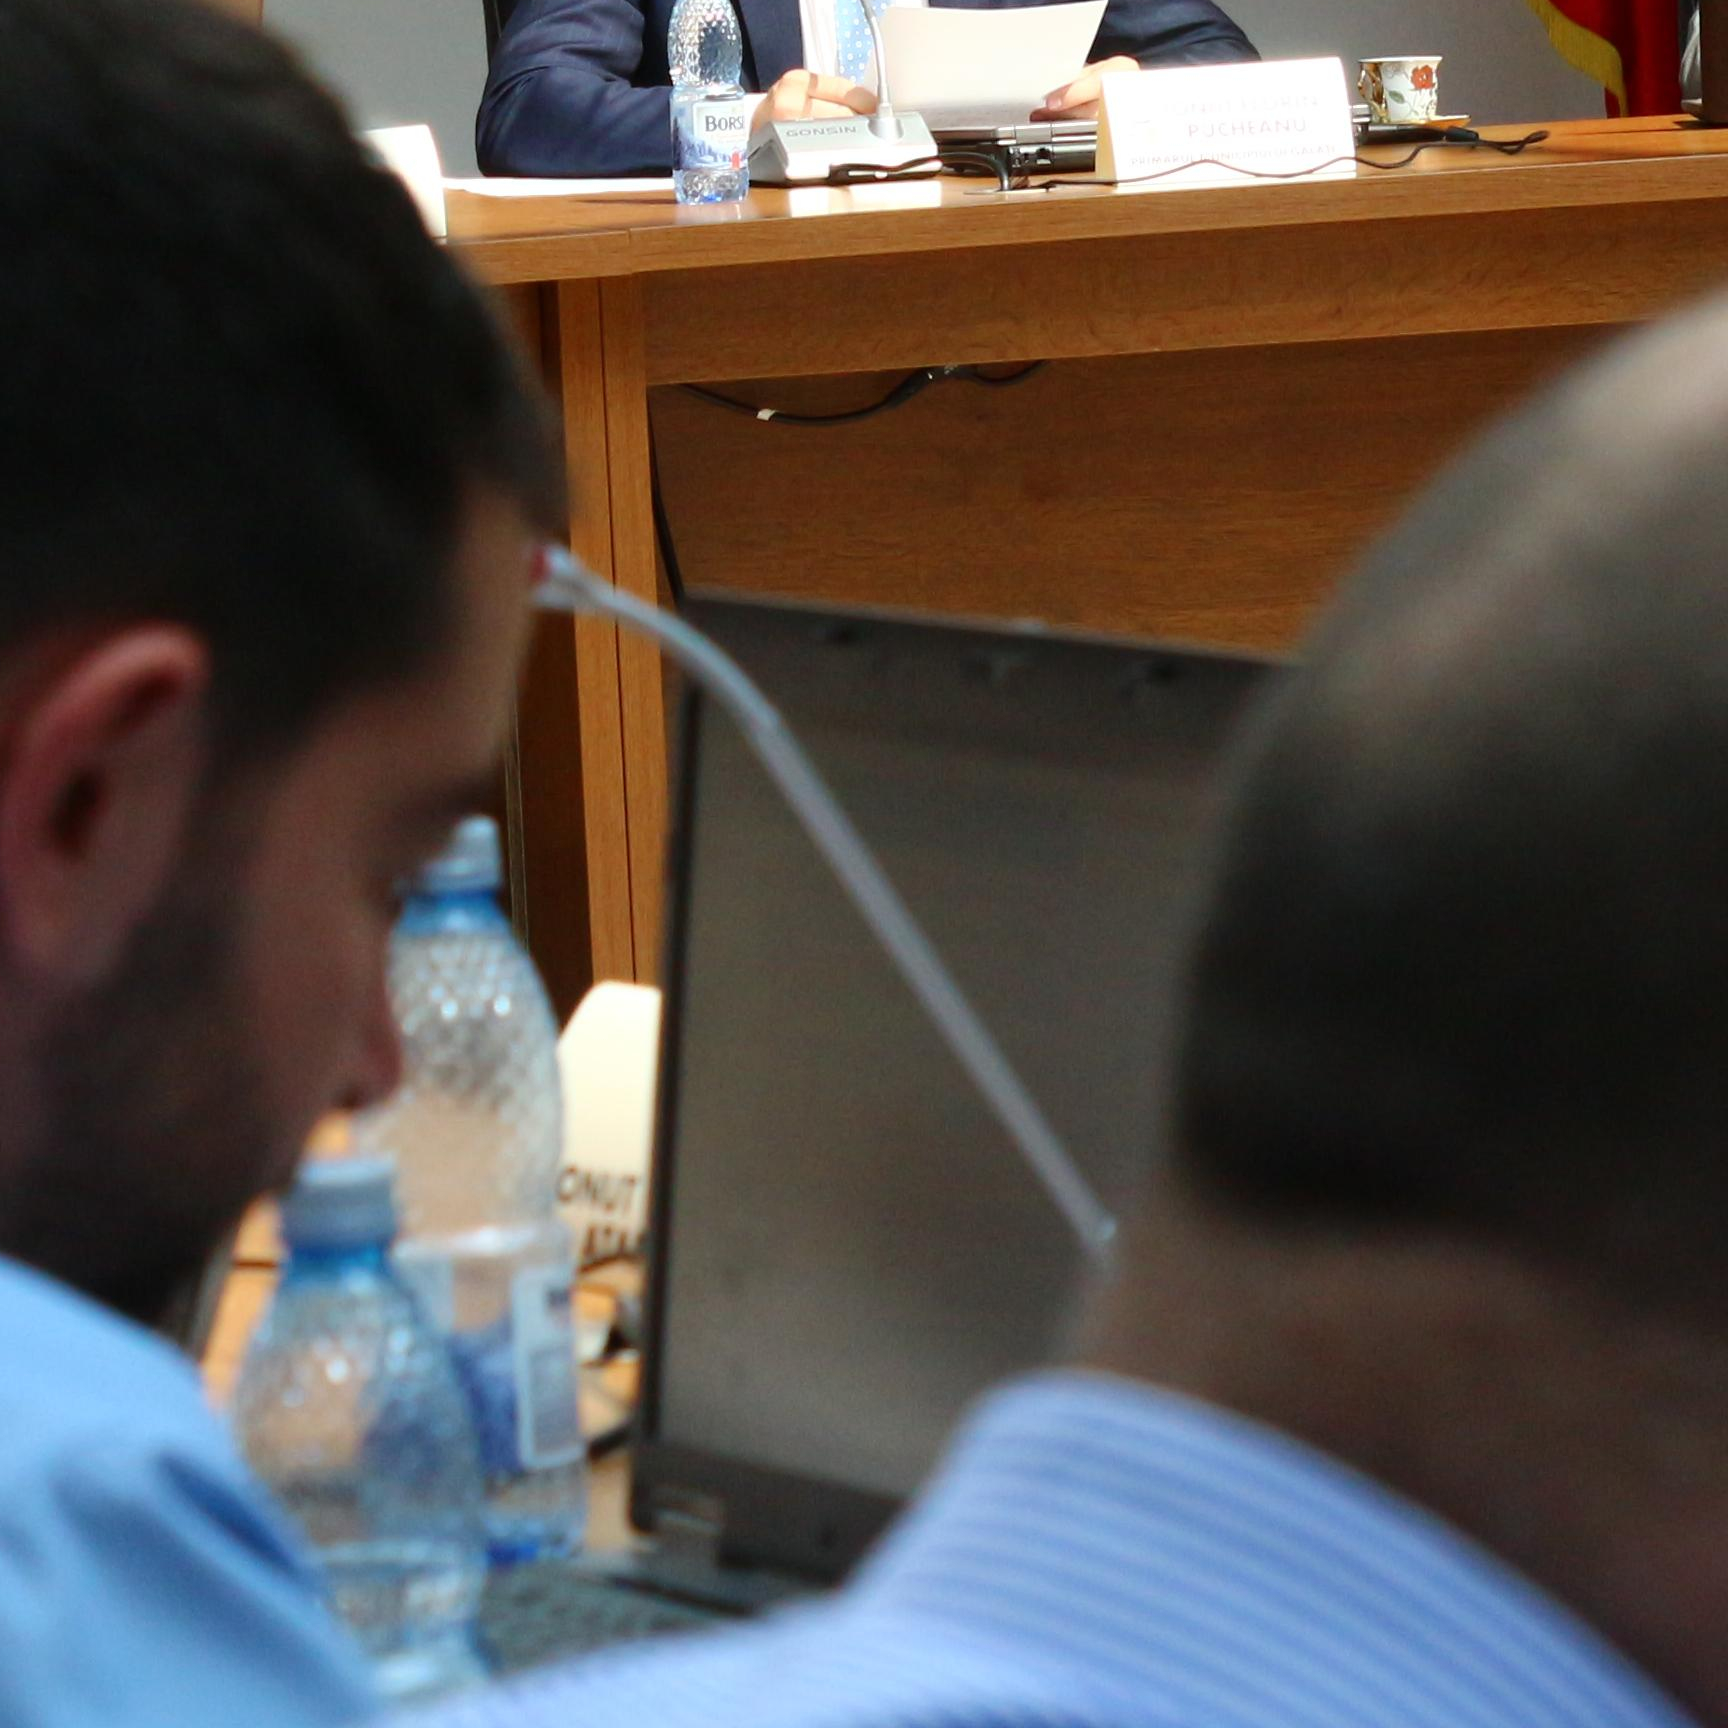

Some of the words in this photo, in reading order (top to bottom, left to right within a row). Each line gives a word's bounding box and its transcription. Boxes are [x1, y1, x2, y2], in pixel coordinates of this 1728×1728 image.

[704, 114, 745, 132] BORS
[785, 125, 857, 138] GONSIN
[1188, 118, 1307, 139] PUCHEANU
